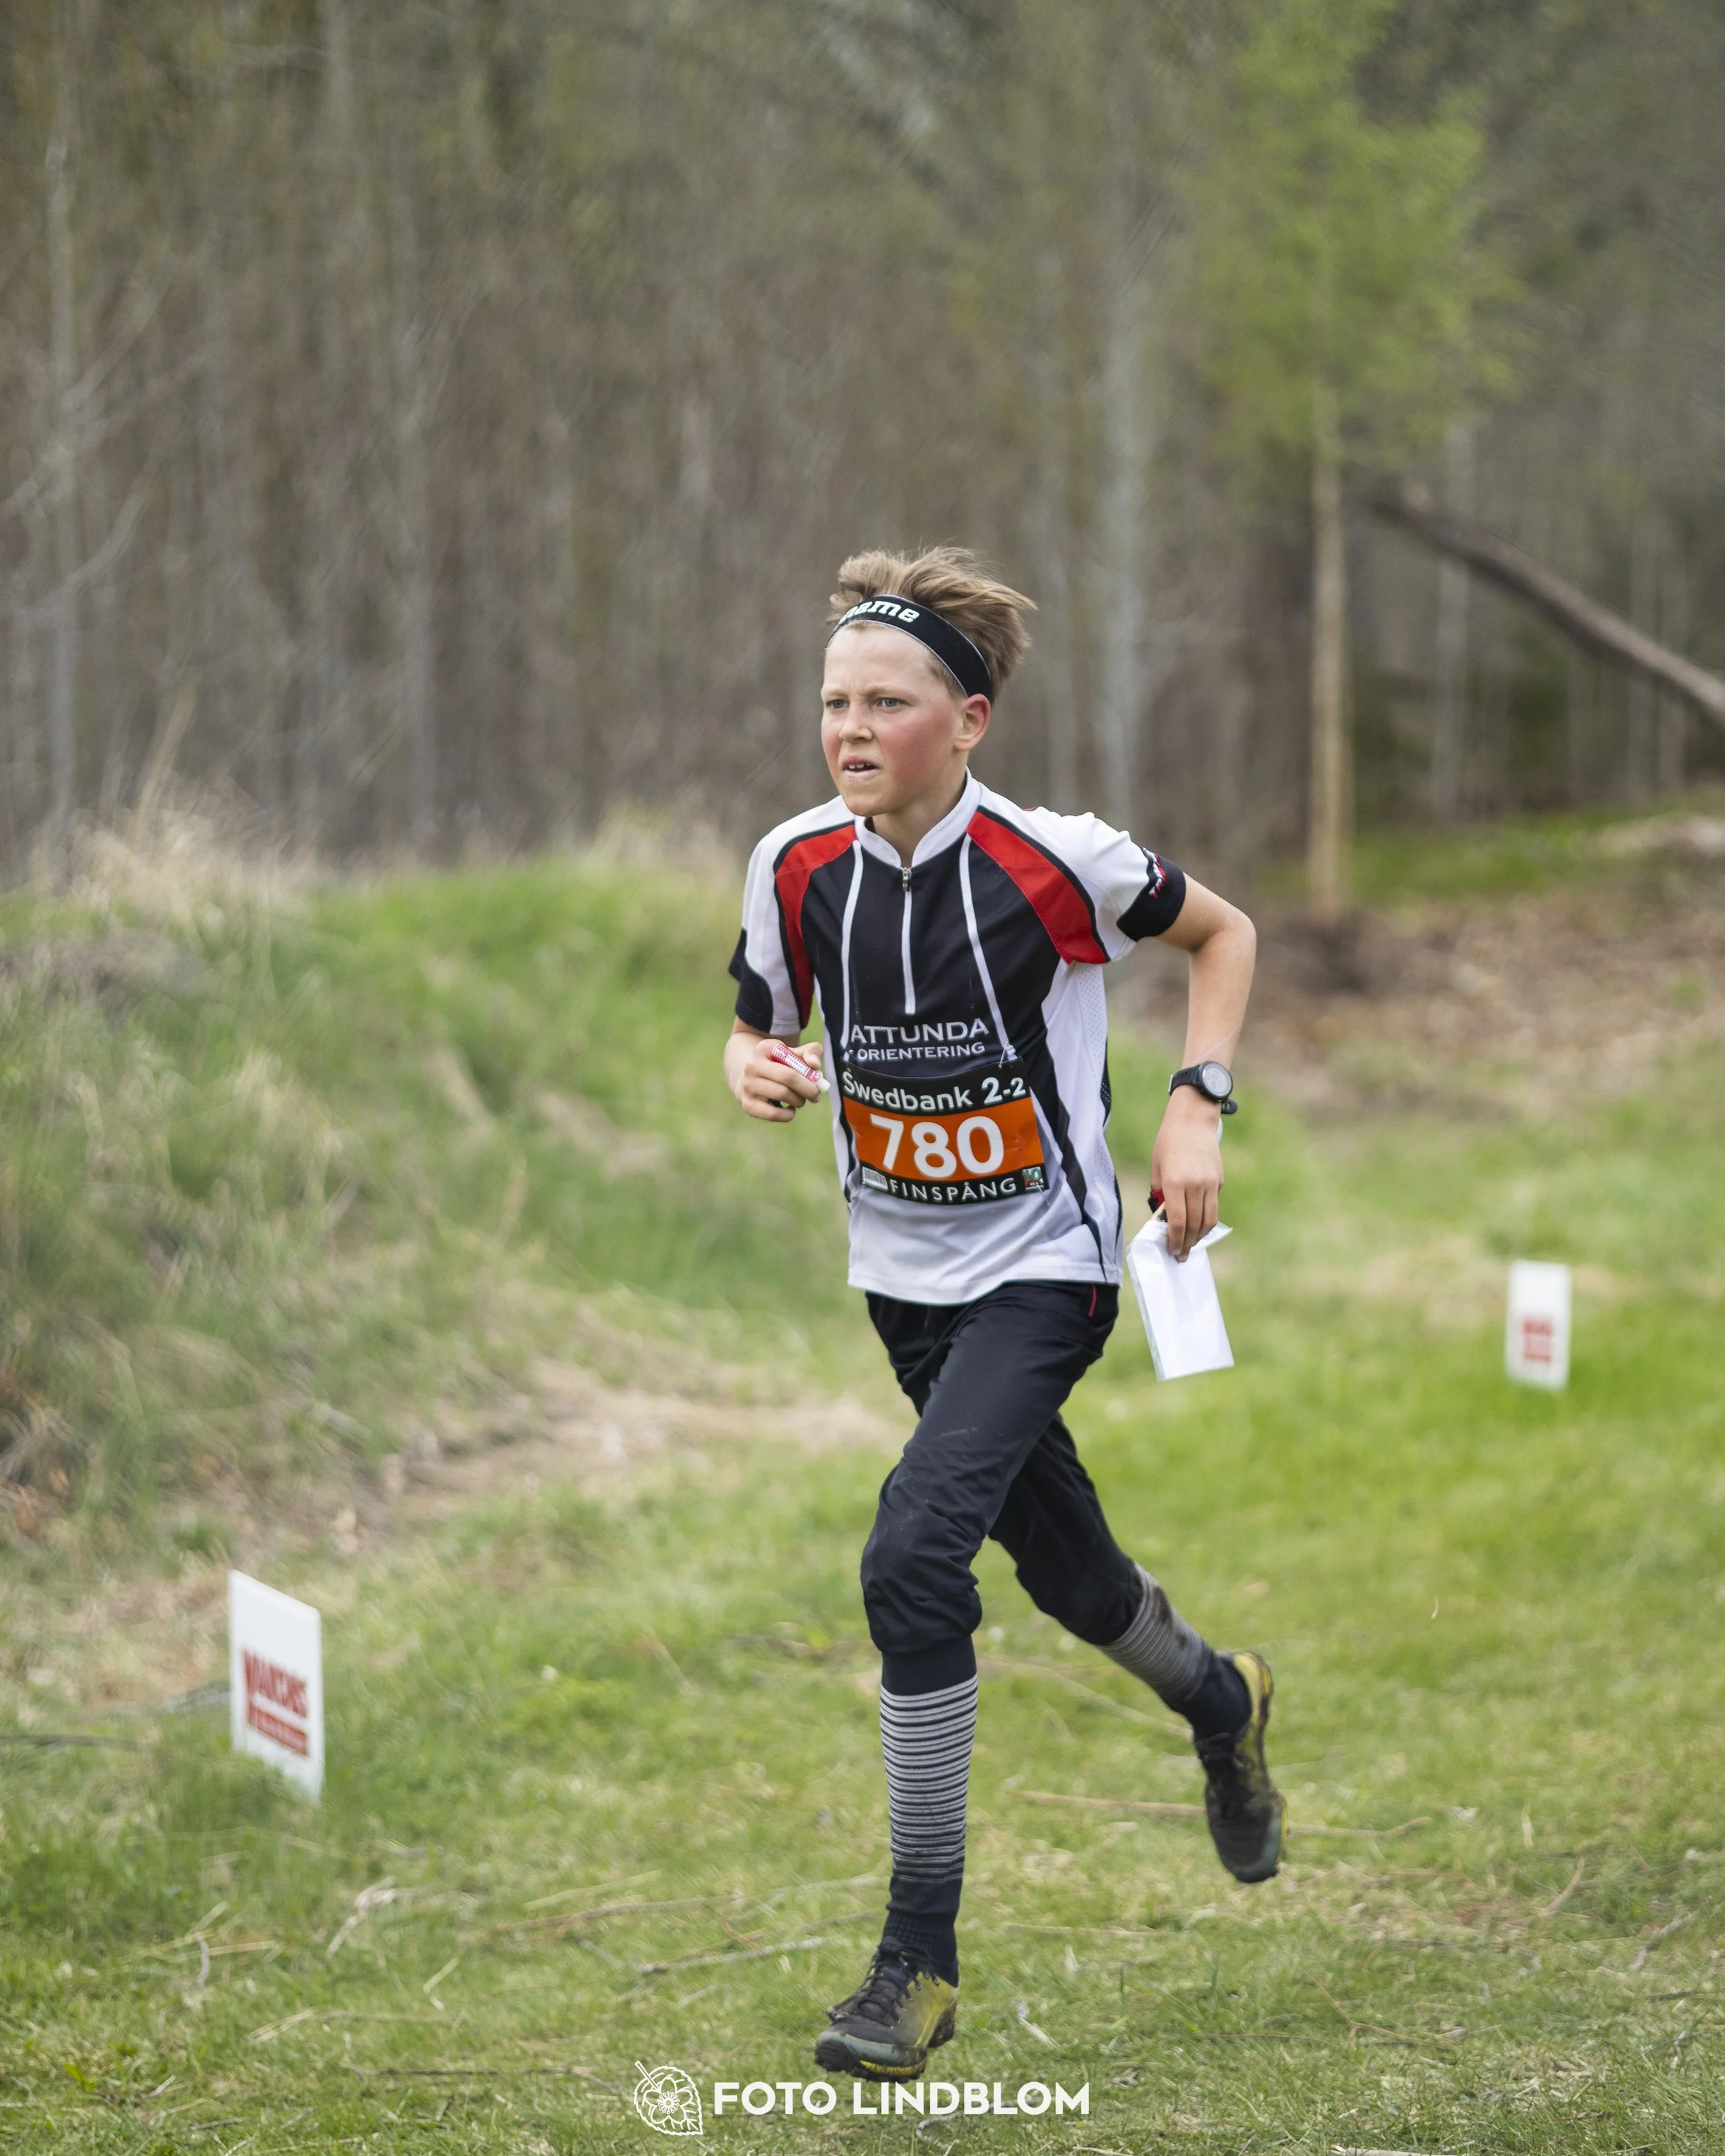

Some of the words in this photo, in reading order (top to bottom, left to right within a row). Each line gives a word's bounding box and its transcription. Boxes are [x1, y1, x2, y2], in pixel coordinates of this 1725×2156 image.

[850, 1018, 989, 1045] ATTUNDA
[858, 1042, 985, 1061] ORIENTERING
[842, 1071, 974, 1112] Swedbank
[981, 1076, 1027, 1105] 2-2
[869, 1115, 1005, 1179] 780
[889, 1177, 1017, 1202] FINSPÅNG
